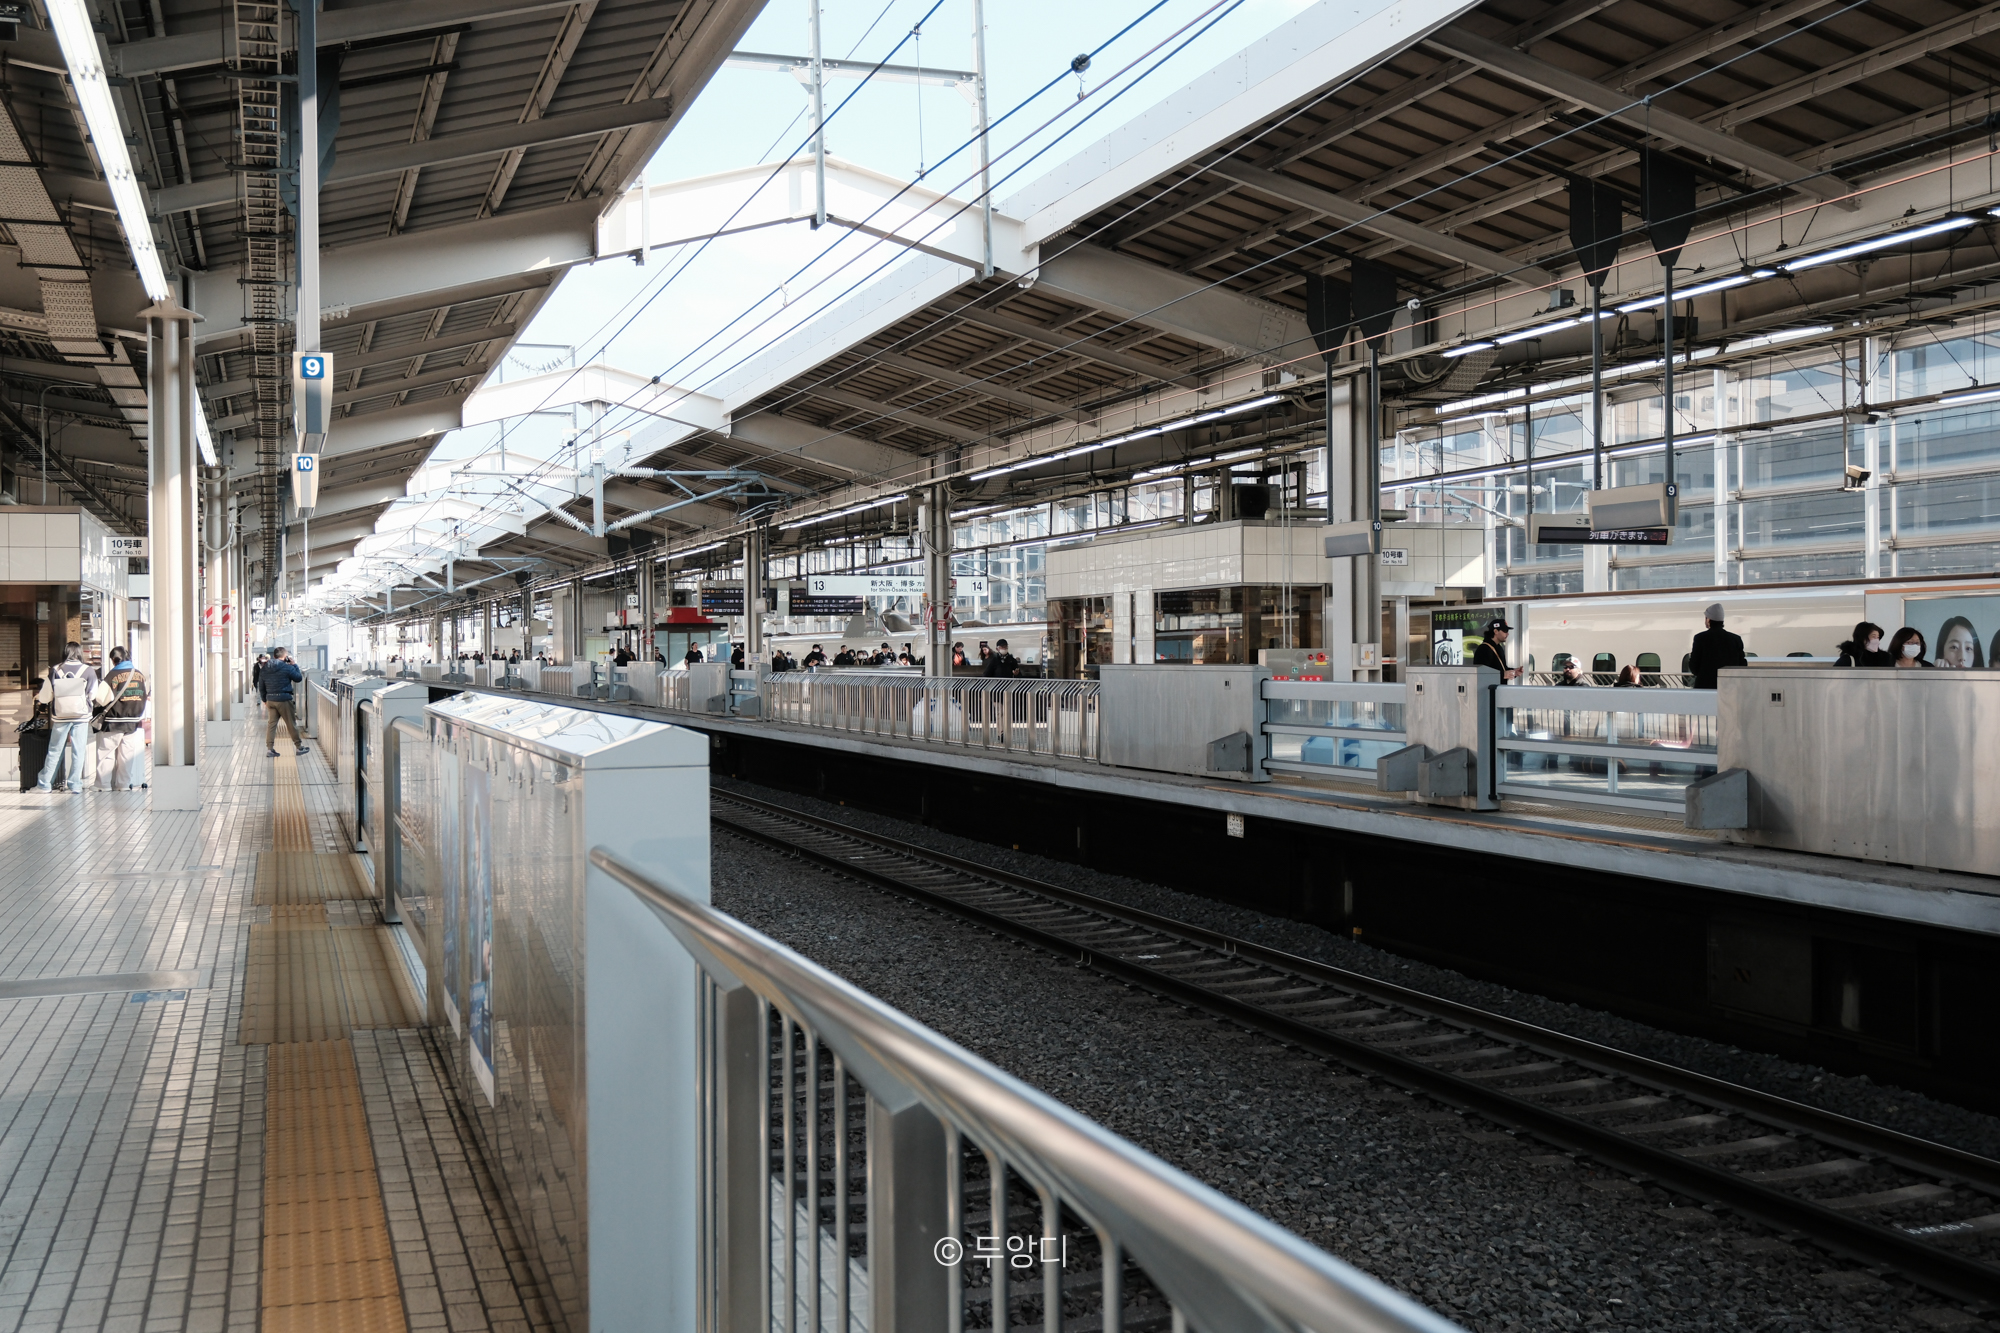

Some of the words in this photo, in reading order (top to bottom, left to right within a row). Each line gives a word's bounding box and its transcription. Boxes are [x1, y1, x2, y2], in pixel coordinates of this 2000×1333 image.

[305, 358, 321, 376] 9
[298, 457, 312, 470] 10
[1668, 485, 1675, 496] 9
[1373, 521, 1381, 531] 10
[111, 539, 142, 549] 10号車
[1382, 550, 1403, 559] 10号車
[813, 580, 825, 591] 13
[972, 581, 983, 591] 14
[628, 596, 637, 604] 13
